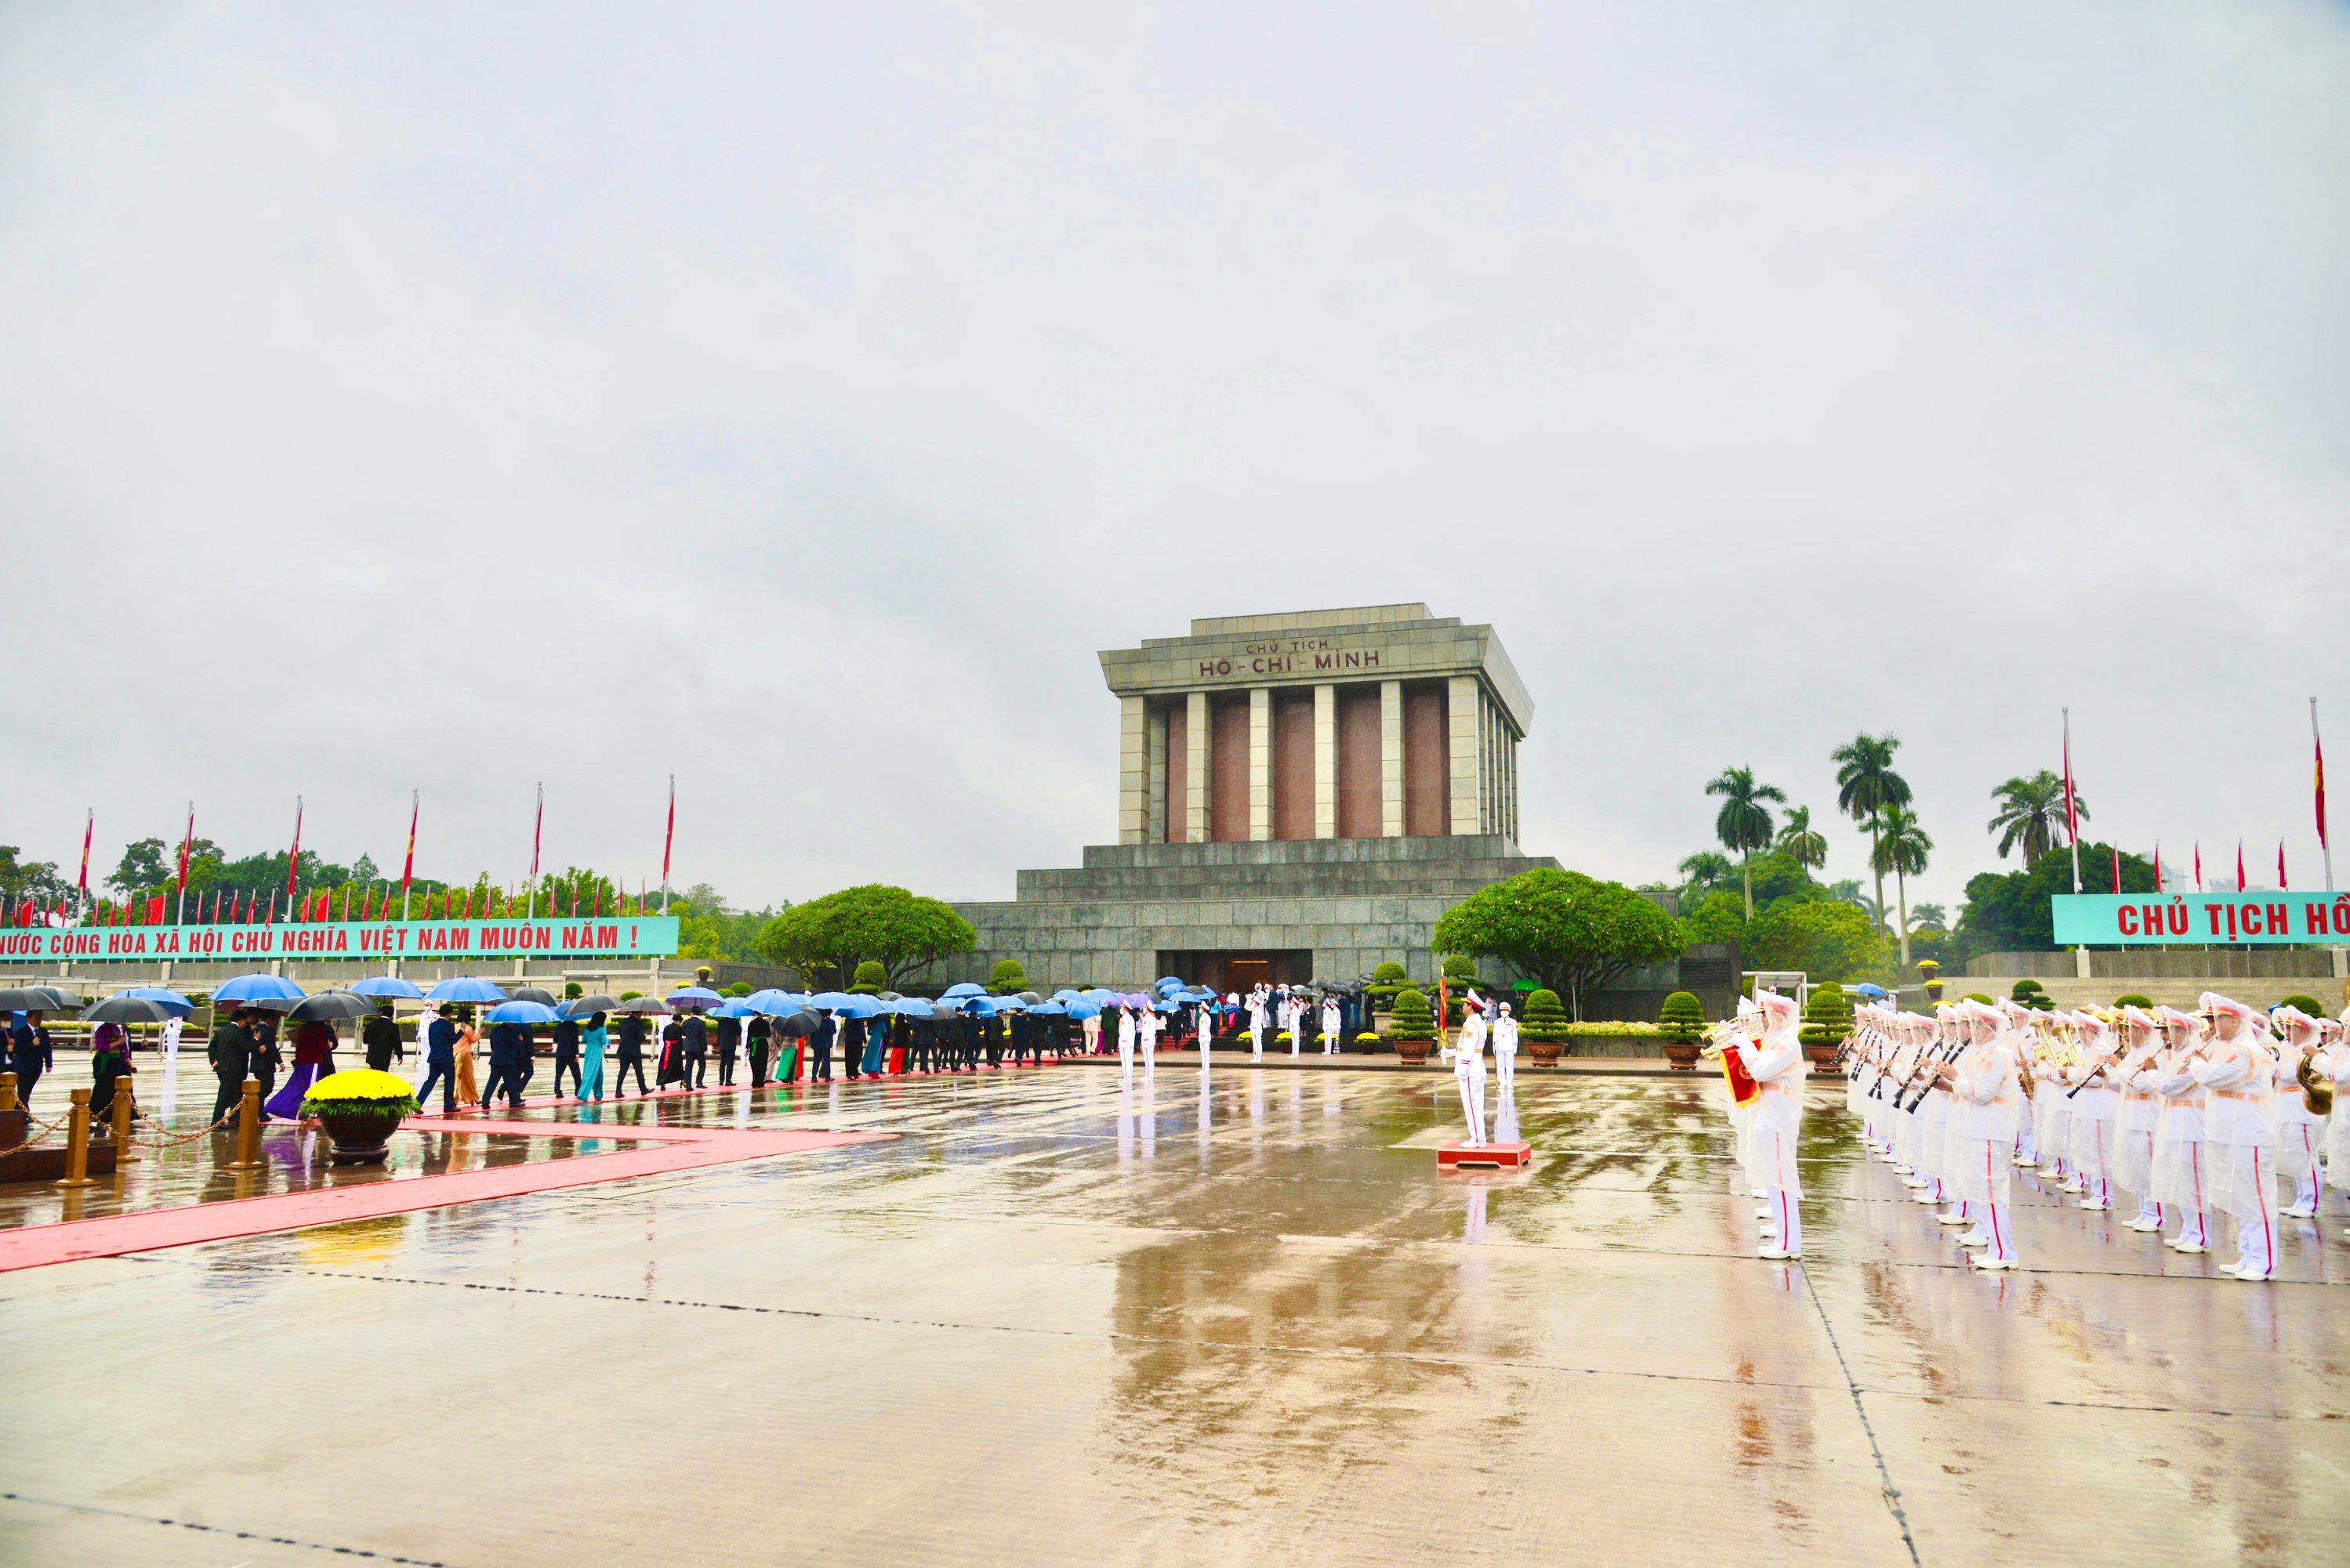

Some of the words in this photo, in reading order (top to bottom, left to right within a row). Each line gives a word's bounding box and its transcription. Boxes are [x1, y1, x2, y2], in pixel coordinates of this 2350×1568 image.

[1199, 657, 1231, 676] HỒ
[1253, 652, 1293, 673] CHÍ
[1315, 648, 1379, 669] MINH
[1246, 639, 1278, 654] CHỦ
[1291, 639, 1328, 654] TỊCH
[2117, 895, 2189, 936] CHỦ
[2204, 903, 2289, 942] TỊCH
[2305, 893, 2350, 935] HỒ
[50, 930, 100, 958] CỘNG
[108, 929, 146, 954] HÒA
[154, 929, 180, 953] XÃ
[189, 928, 223, 956] HỘI
[231, 924, 273, 952] CHỦ
[282, 925, 347, 951] NGHĨA
[360, 924, 408, 954] VIỆT
[418, 928, 470, 950] NAM
[480, 922, 551, 949] MUÔN
[562, 921, 618, 948] NĂM
